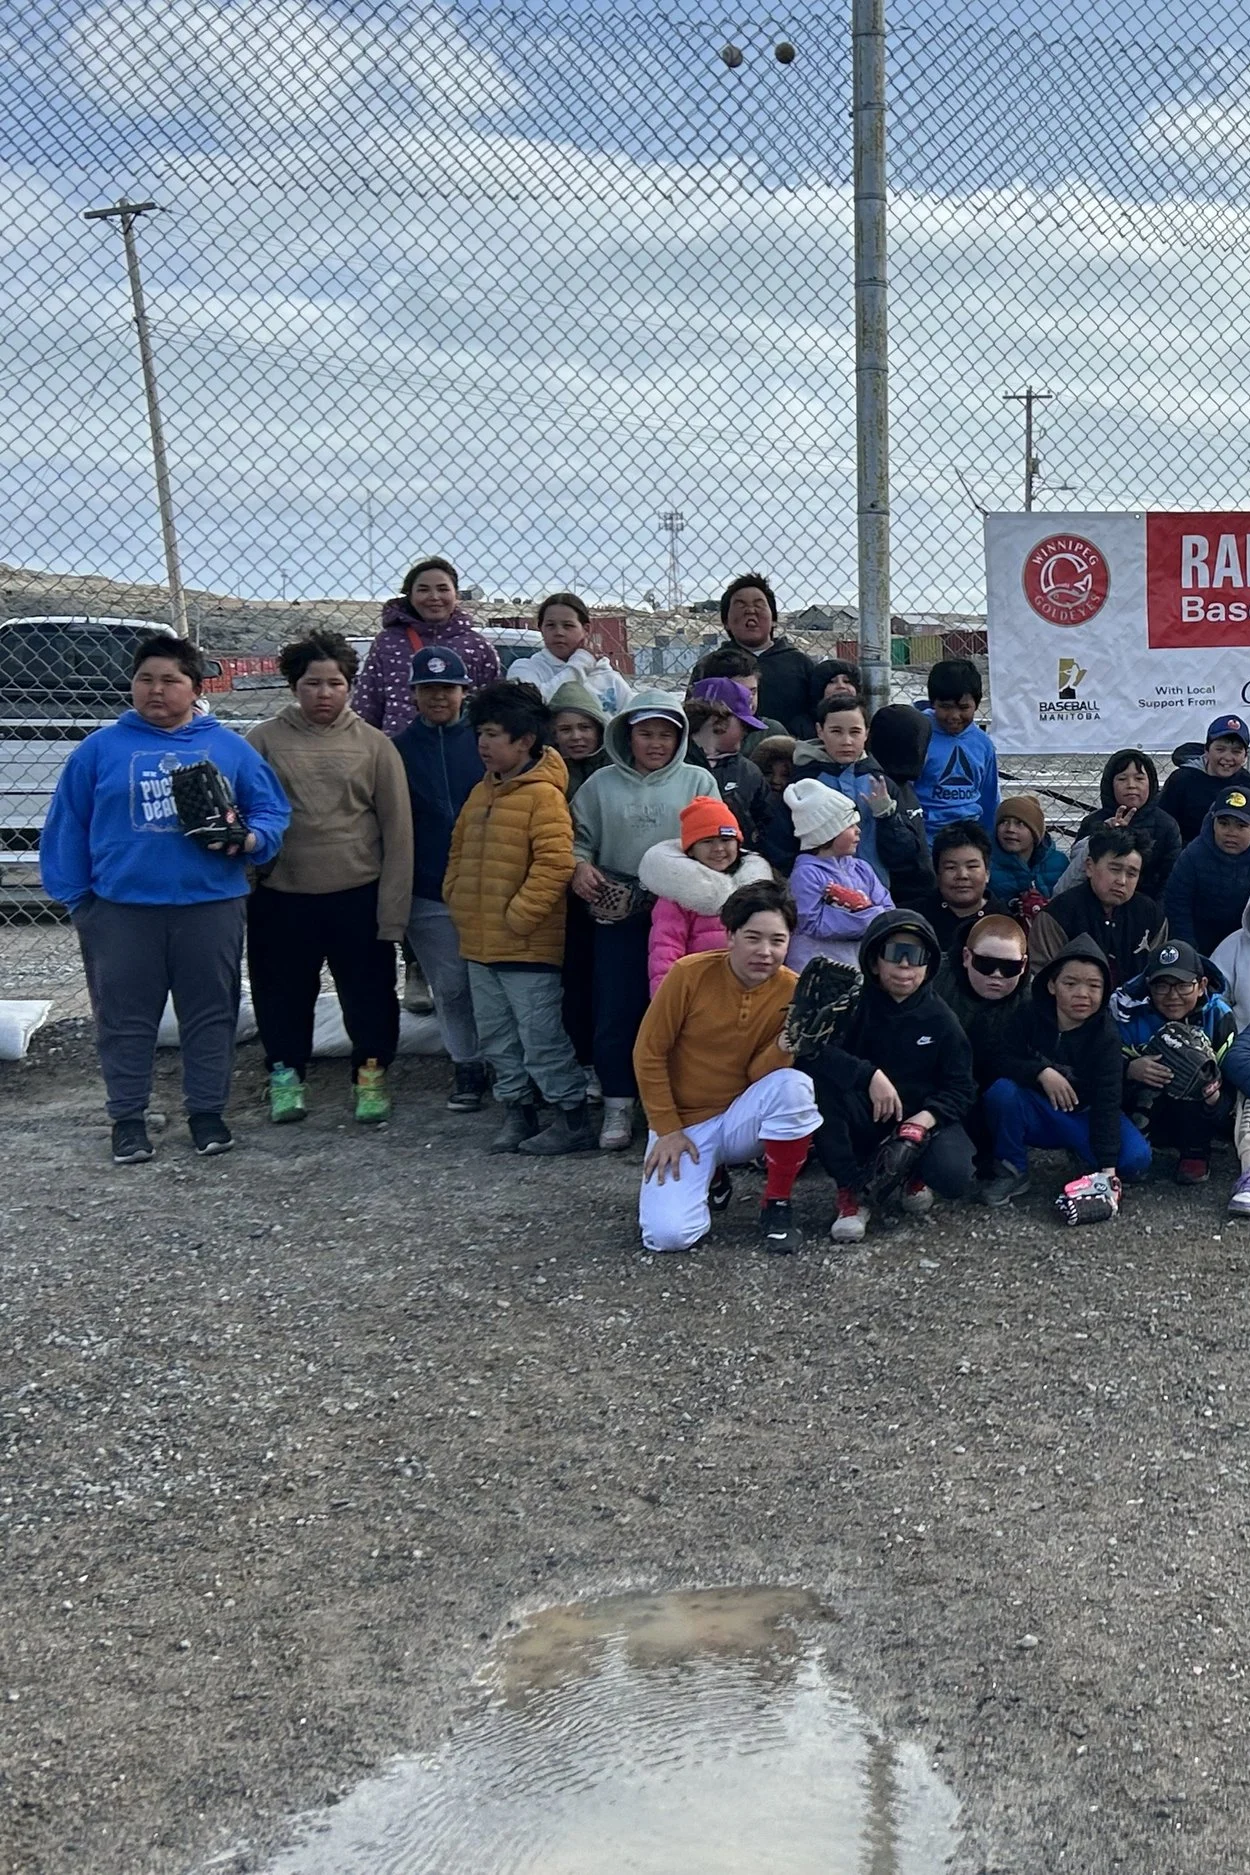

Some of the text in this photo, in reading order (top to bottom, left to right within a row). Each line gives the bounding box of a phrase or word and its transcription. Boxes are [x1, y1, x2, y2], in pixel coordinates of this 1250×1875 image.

[1032, 540, 1099, 566] WINNIPEG
[1034, 592, 1101, 621] GOLDEYES
[1155, 685, 1216, 696] With Local
[1039, 702, 1100, 712] BASEBALL
[1138, 697, 1217, 709] Support From
[1039, 712, 1101, 721] MANITOBA
[140, 776, 173, 801] PUC
